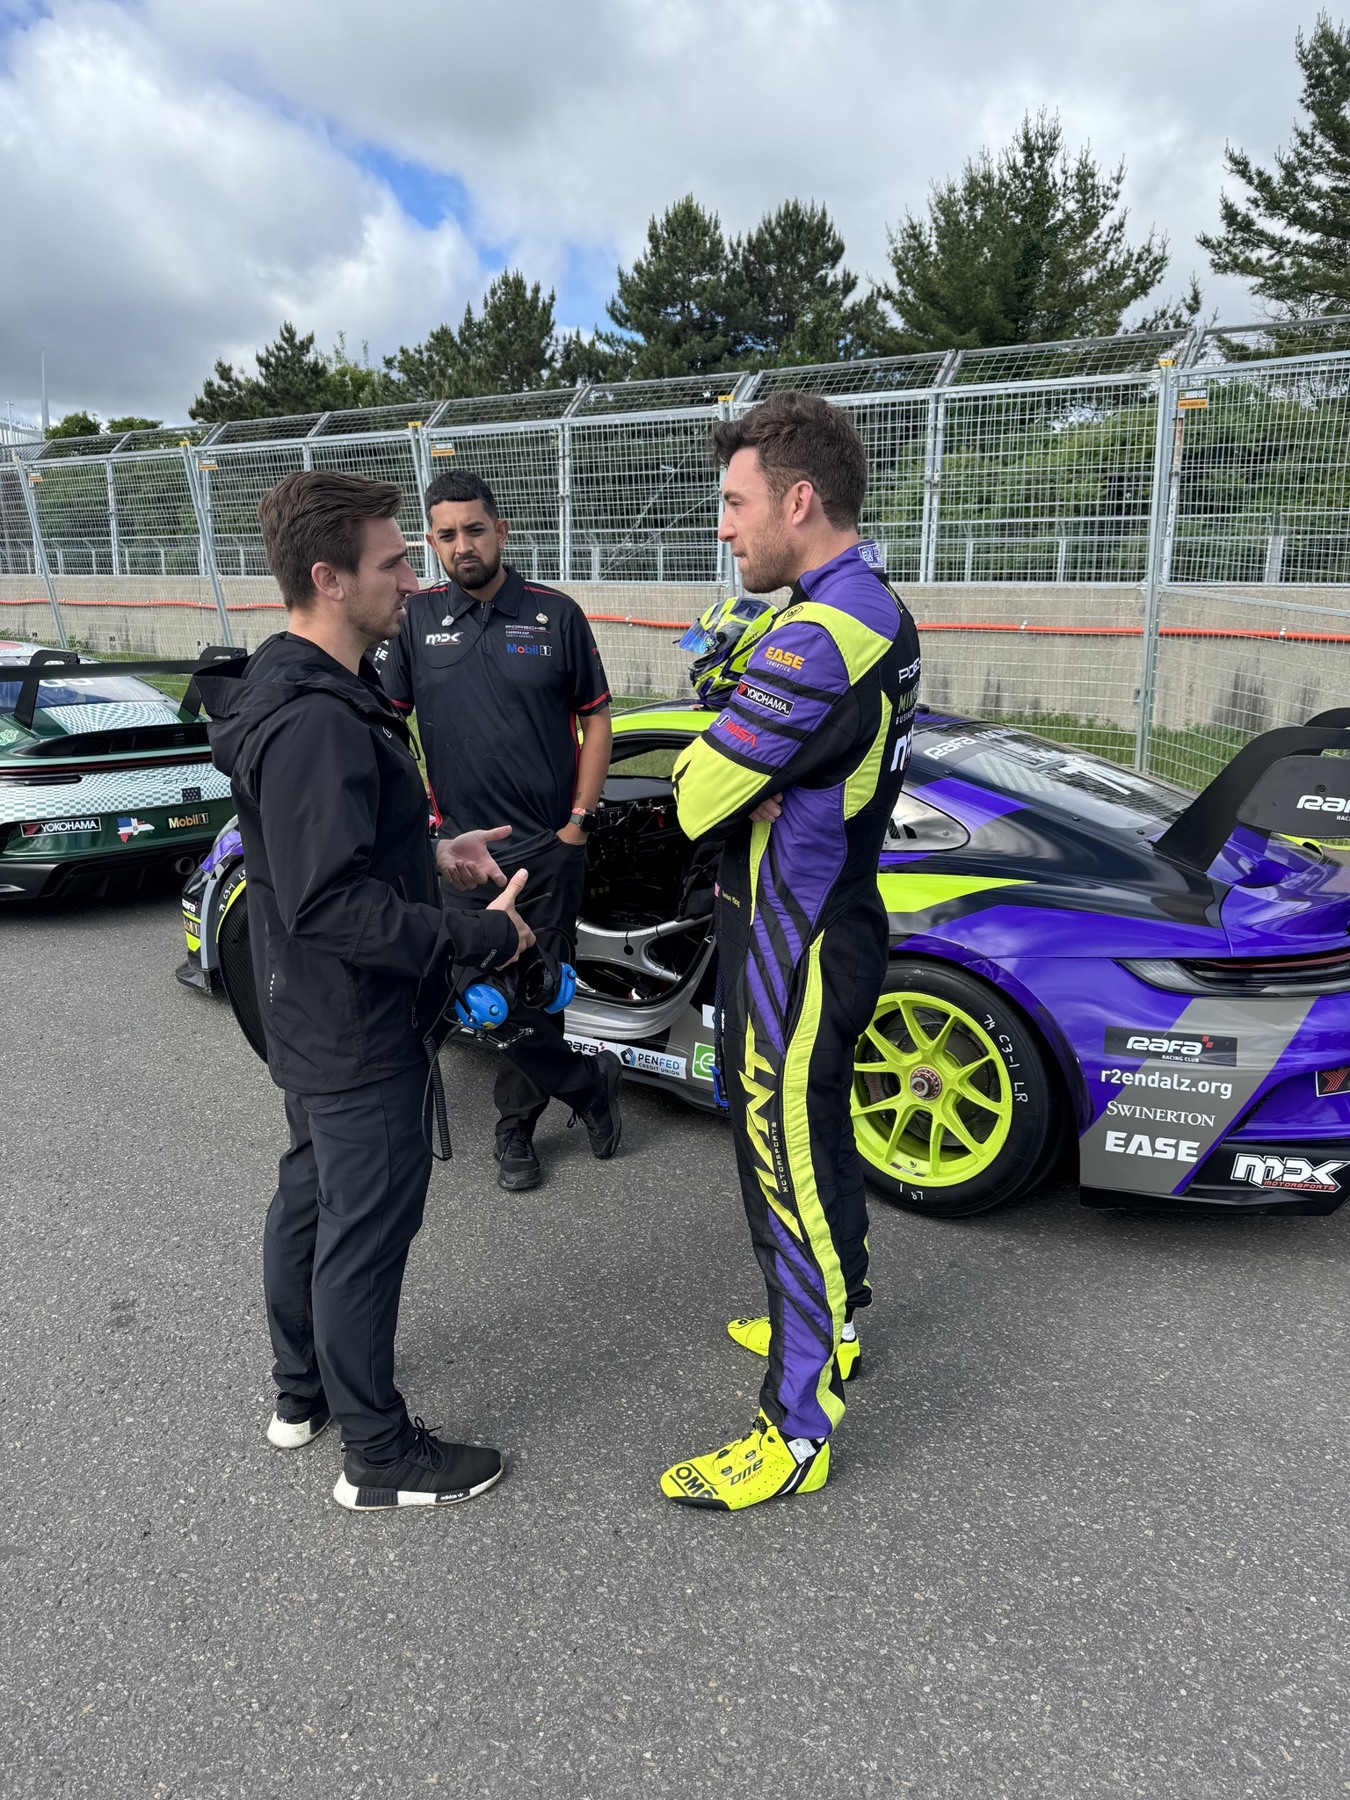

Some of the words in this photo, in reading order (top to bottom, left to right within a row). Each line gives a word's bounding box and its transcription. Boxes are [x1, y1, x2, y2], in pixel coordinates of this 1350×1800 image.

[506, 643, 538, 655] Mobil
[765, 646, 806, 670] EASE
[747, 687, 790, 714] YOKOHAMA
[41, 820, 99, 833] YOKOHAMA
[168, 815, 199, 829] Mobil
[638, 1053, 680, 1070] PENFED
[984, 1014, 996, 1030] 74
[1014, 1082, 1028, 1102] LR
[638, 1062, 660, 1072] CREDIT
[661, 1068, 680, 1076] UNION
[1101, 1069, 1233, 1099] r2endalz.org
[1105, 1131, 1201, 1162] EASE
[771, 1122, 789, 1193] MOTORSPORTS
[1264, 1181, 1337, 1192] MOTORSPORTS
